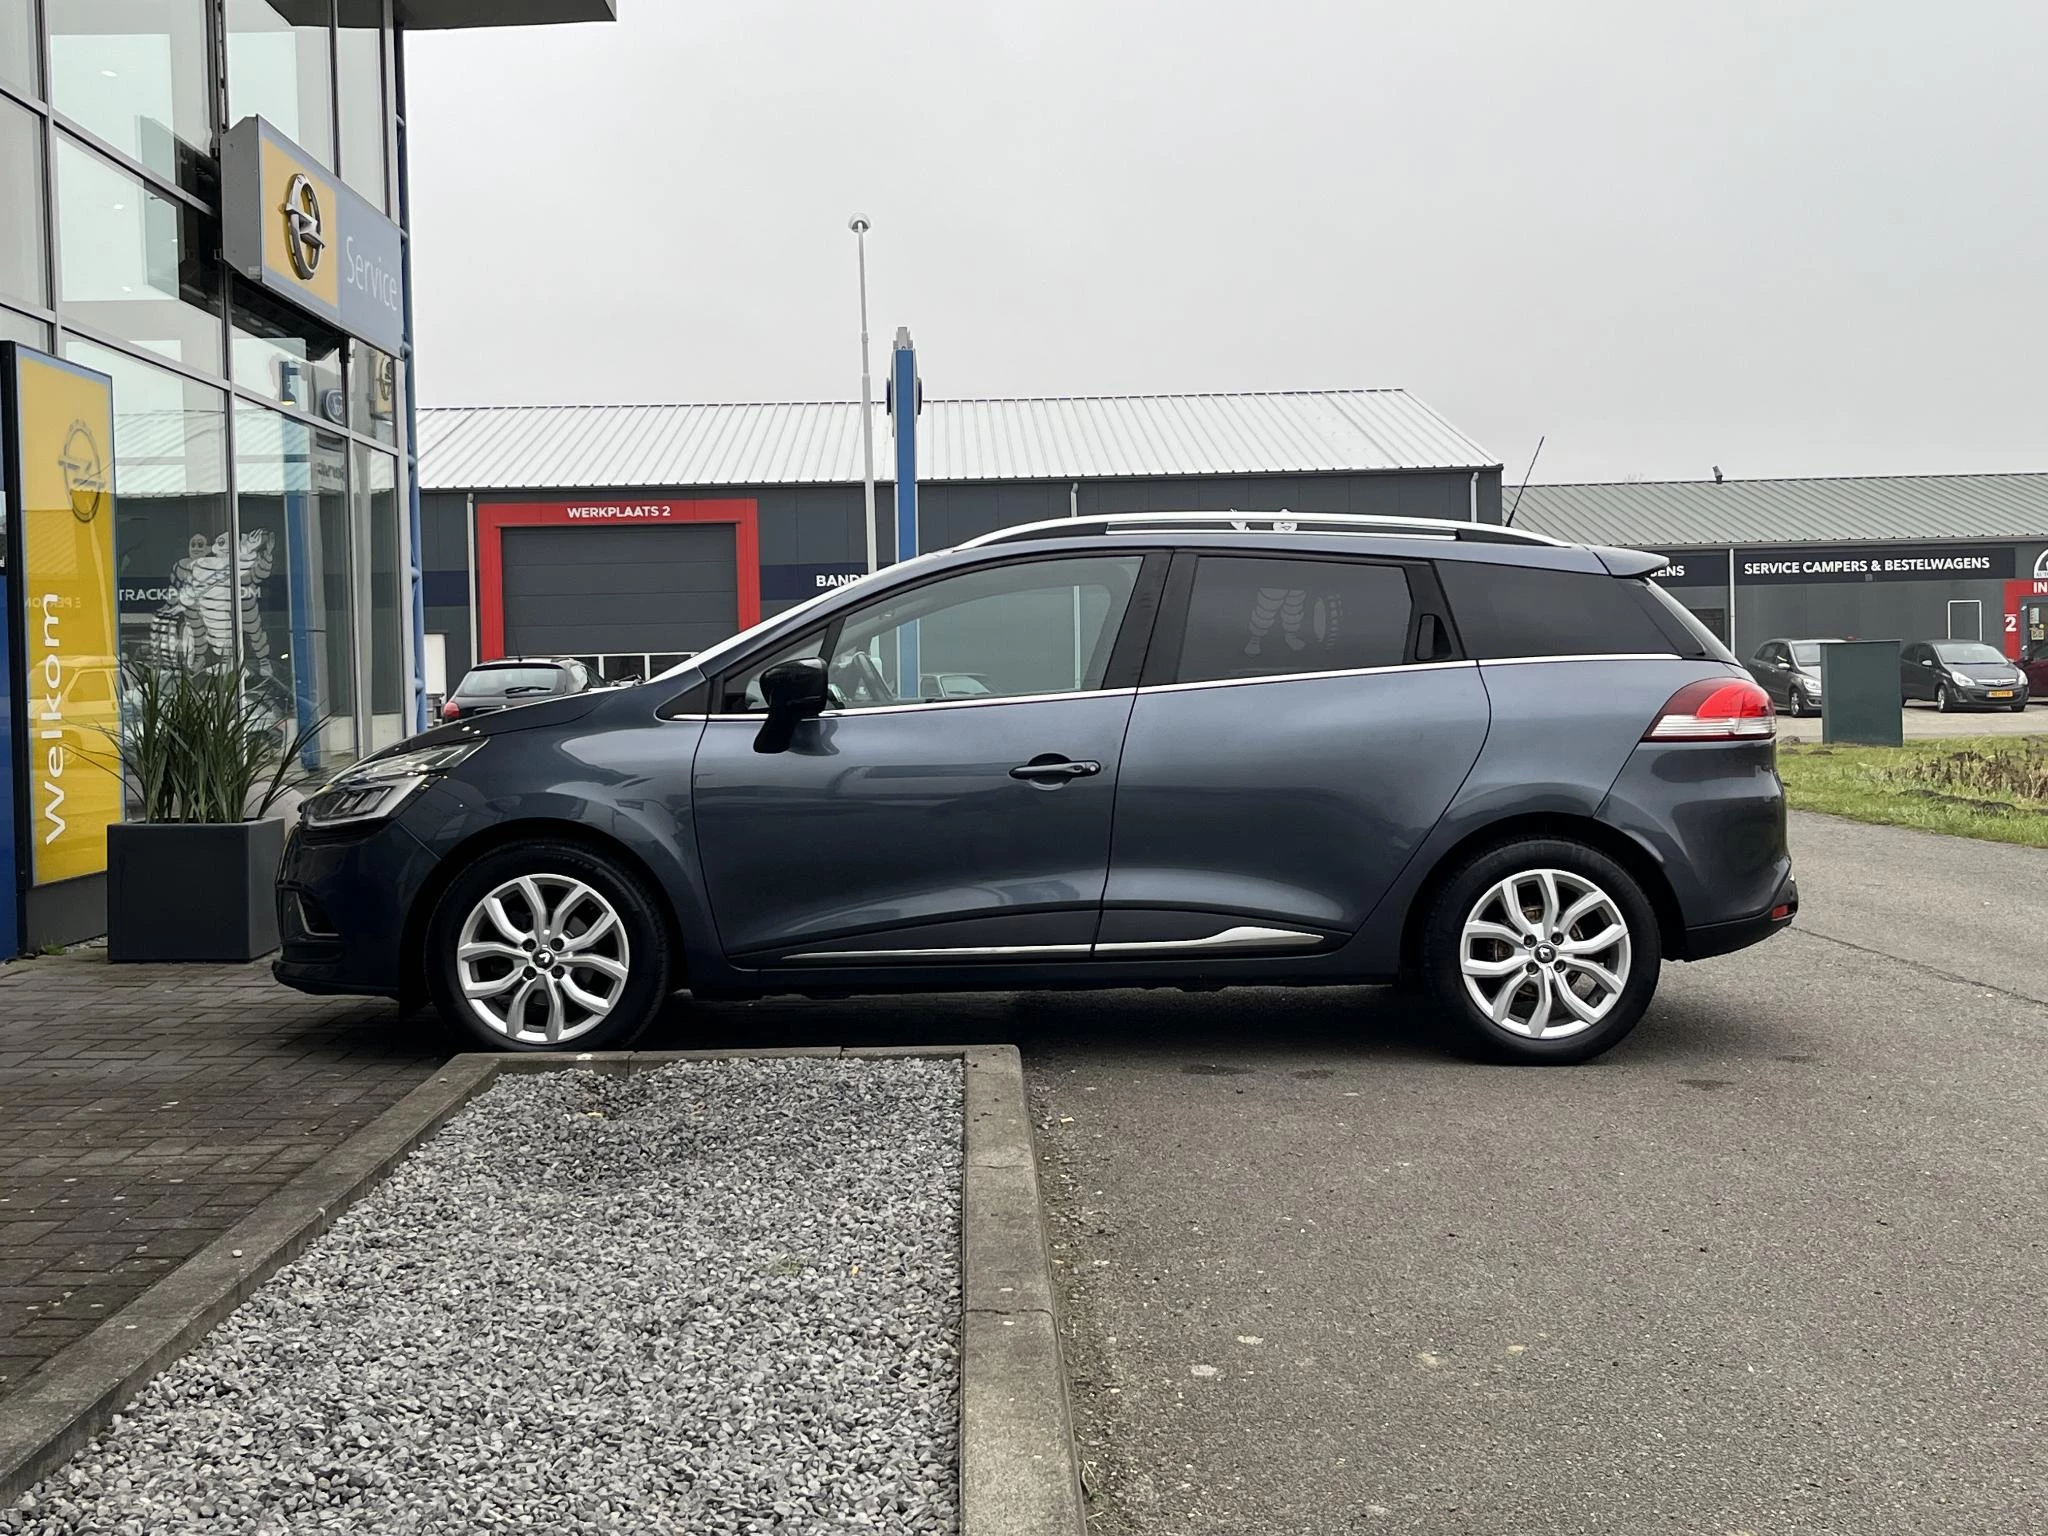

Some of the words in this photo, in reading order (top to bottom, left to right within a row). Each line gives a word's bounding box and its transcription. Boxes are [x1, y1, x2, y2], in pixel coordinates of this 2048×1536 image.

[346, 236, 397, 311] Service
[567, 506, 660, 518] WERKPLAATS
[662, 505, 671, 516] 2
[1744, 562, 1800, 574] SERVICE
[1802, 560, 1868, 573] CAMPERS
[1870, 560, 1882, 571] &
[1884, 557, 1990, 571] BESTELWAGENS
[2005, 616, 2017, 632] 2
[40, 594, 66, 845] Welkom
